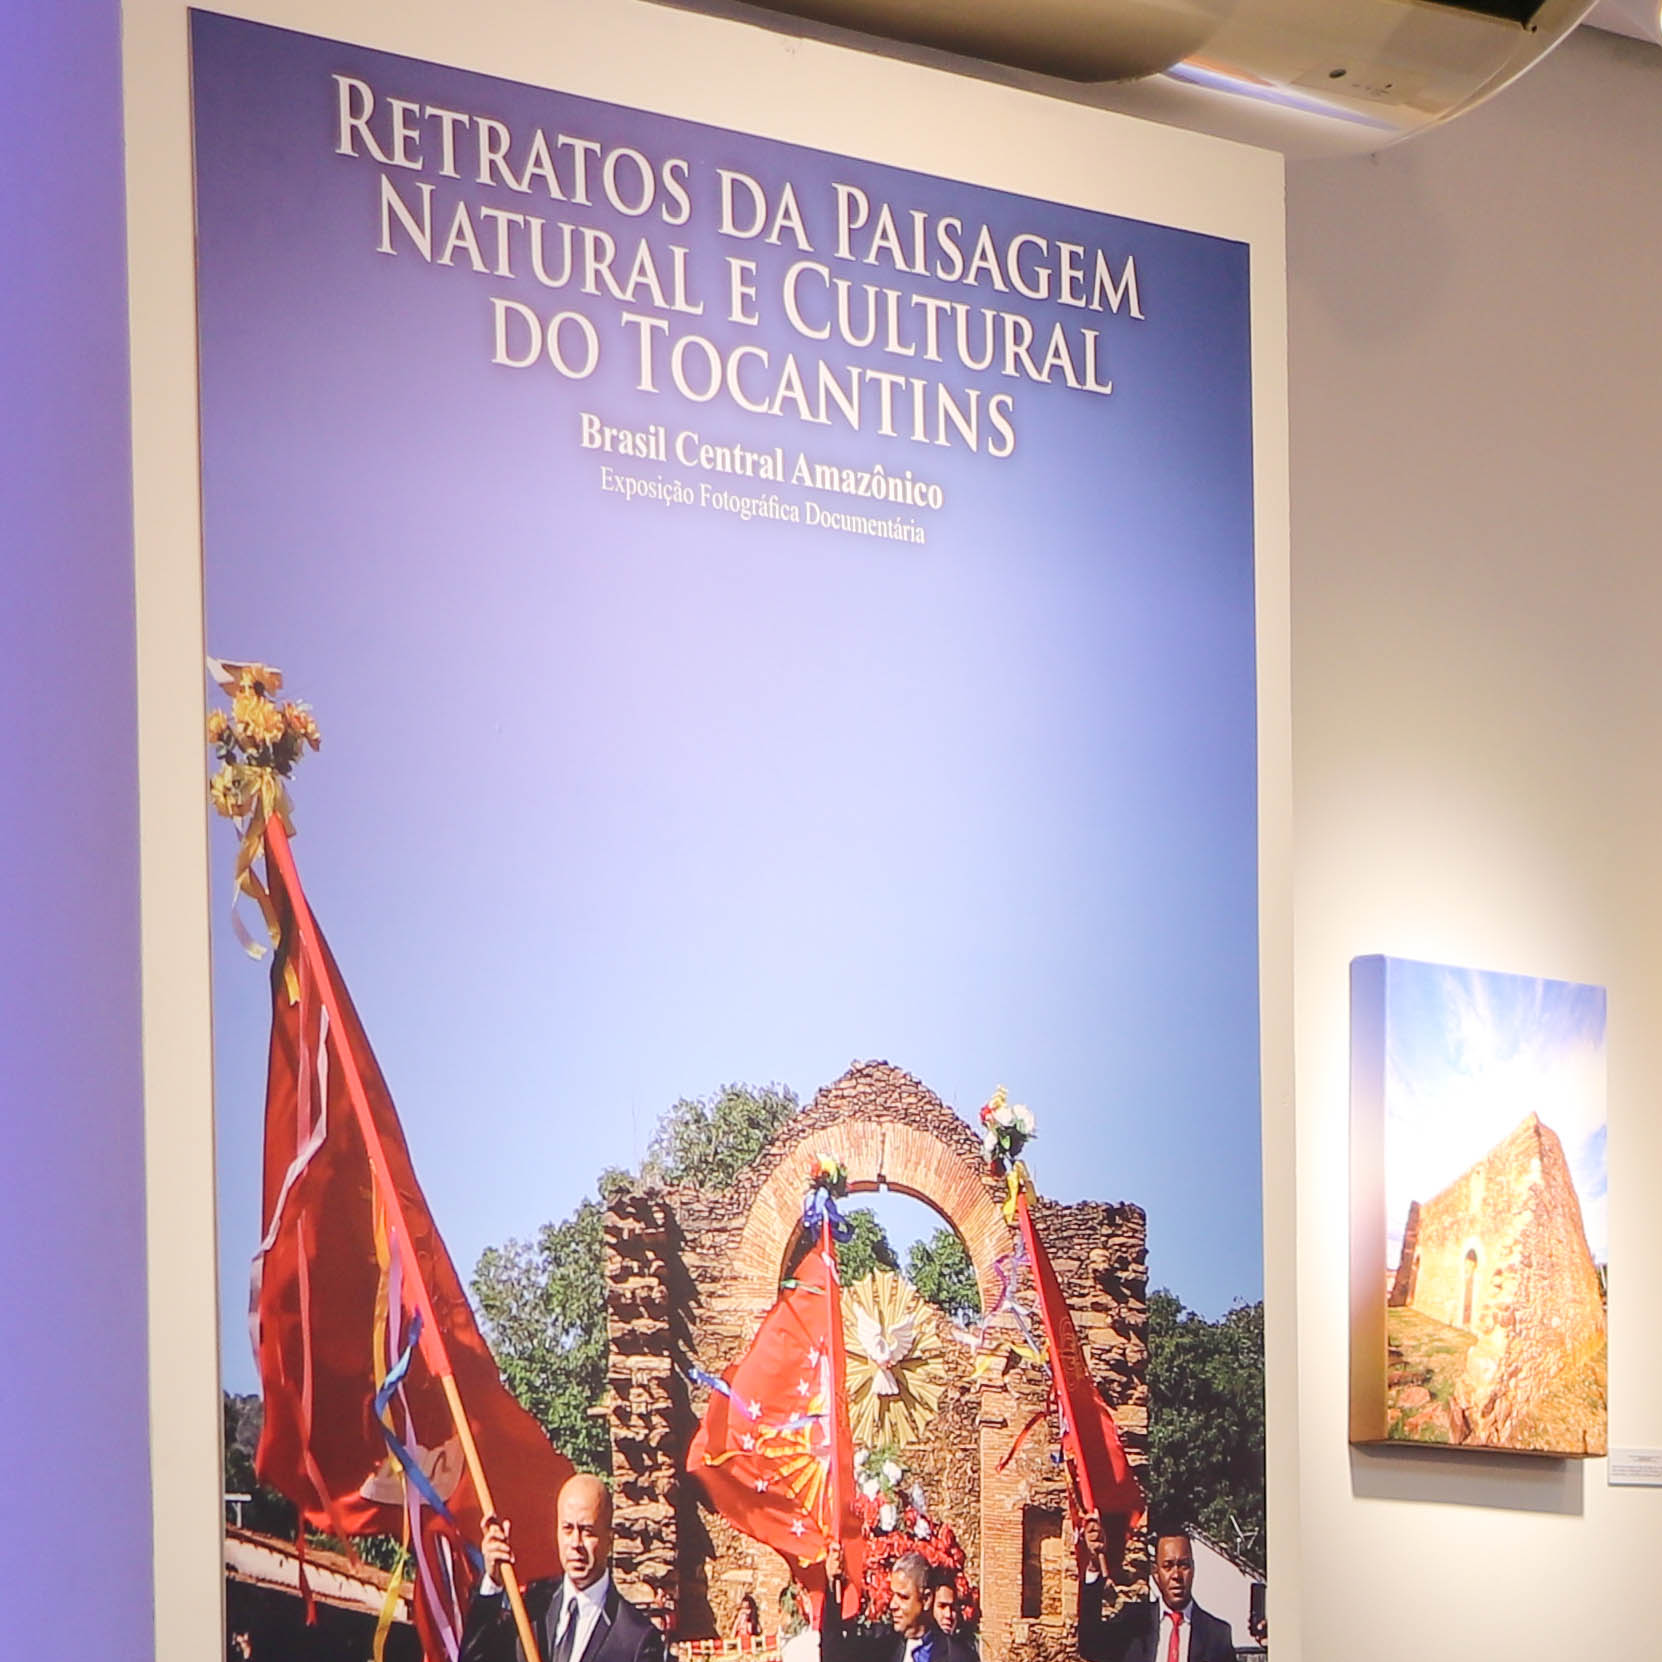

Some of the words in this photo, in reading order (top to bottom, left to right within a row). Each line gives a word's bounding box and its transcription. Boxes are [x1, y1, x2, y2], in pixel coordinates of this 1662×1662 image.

[580, 412, 666, 464] Brasil
[675, 430, 784, 483] Central
[791, 454, 944, 511] Amazônico
[600, 466, 694, 507] Exposição
[700, 482, 800, 527] Fotográfica
[805, 499, 926, 545] Documentária
